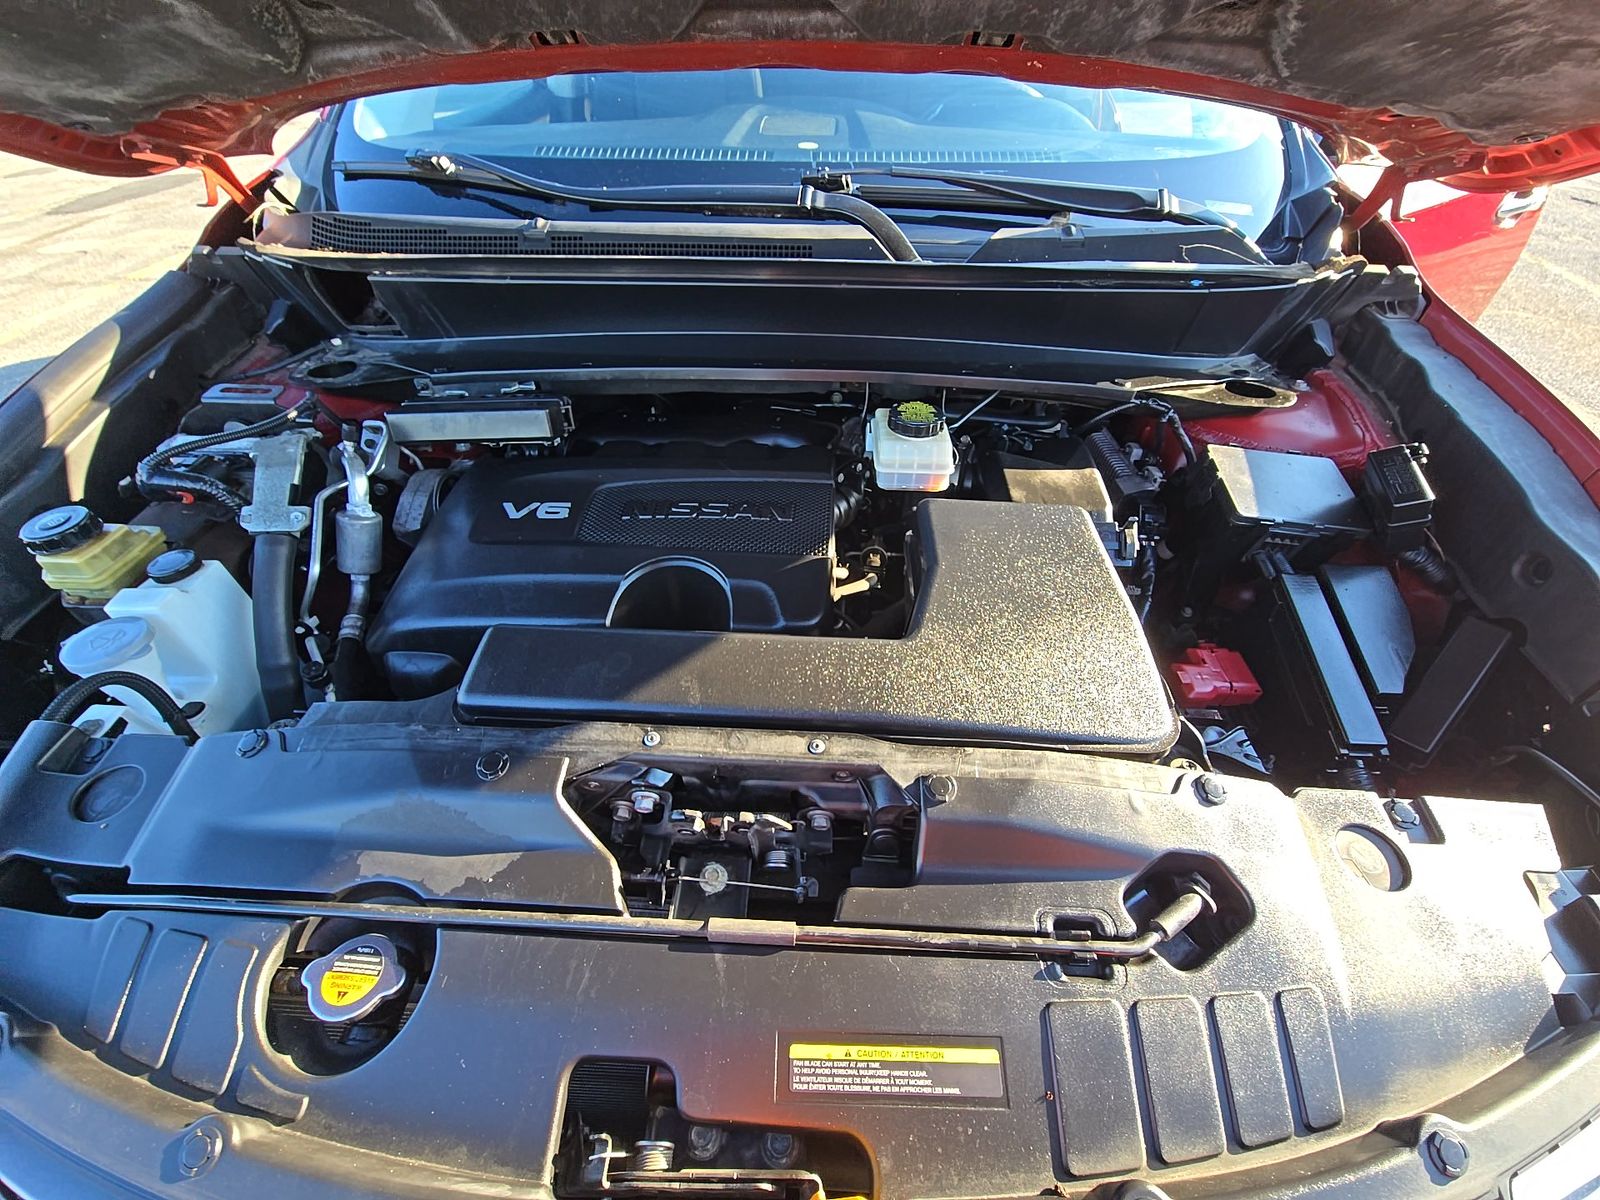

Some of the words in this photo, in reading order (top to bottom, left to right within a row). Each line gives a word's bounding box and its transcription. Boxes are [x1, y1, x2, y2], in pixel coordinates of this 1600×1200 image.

[502, 501, 572, 519] V6
[621, 501, 794, 521] NISSAN
[856, 1049, 892, 1058] CAUTION
[901, 1051, 944, 1059] ATTENTION
